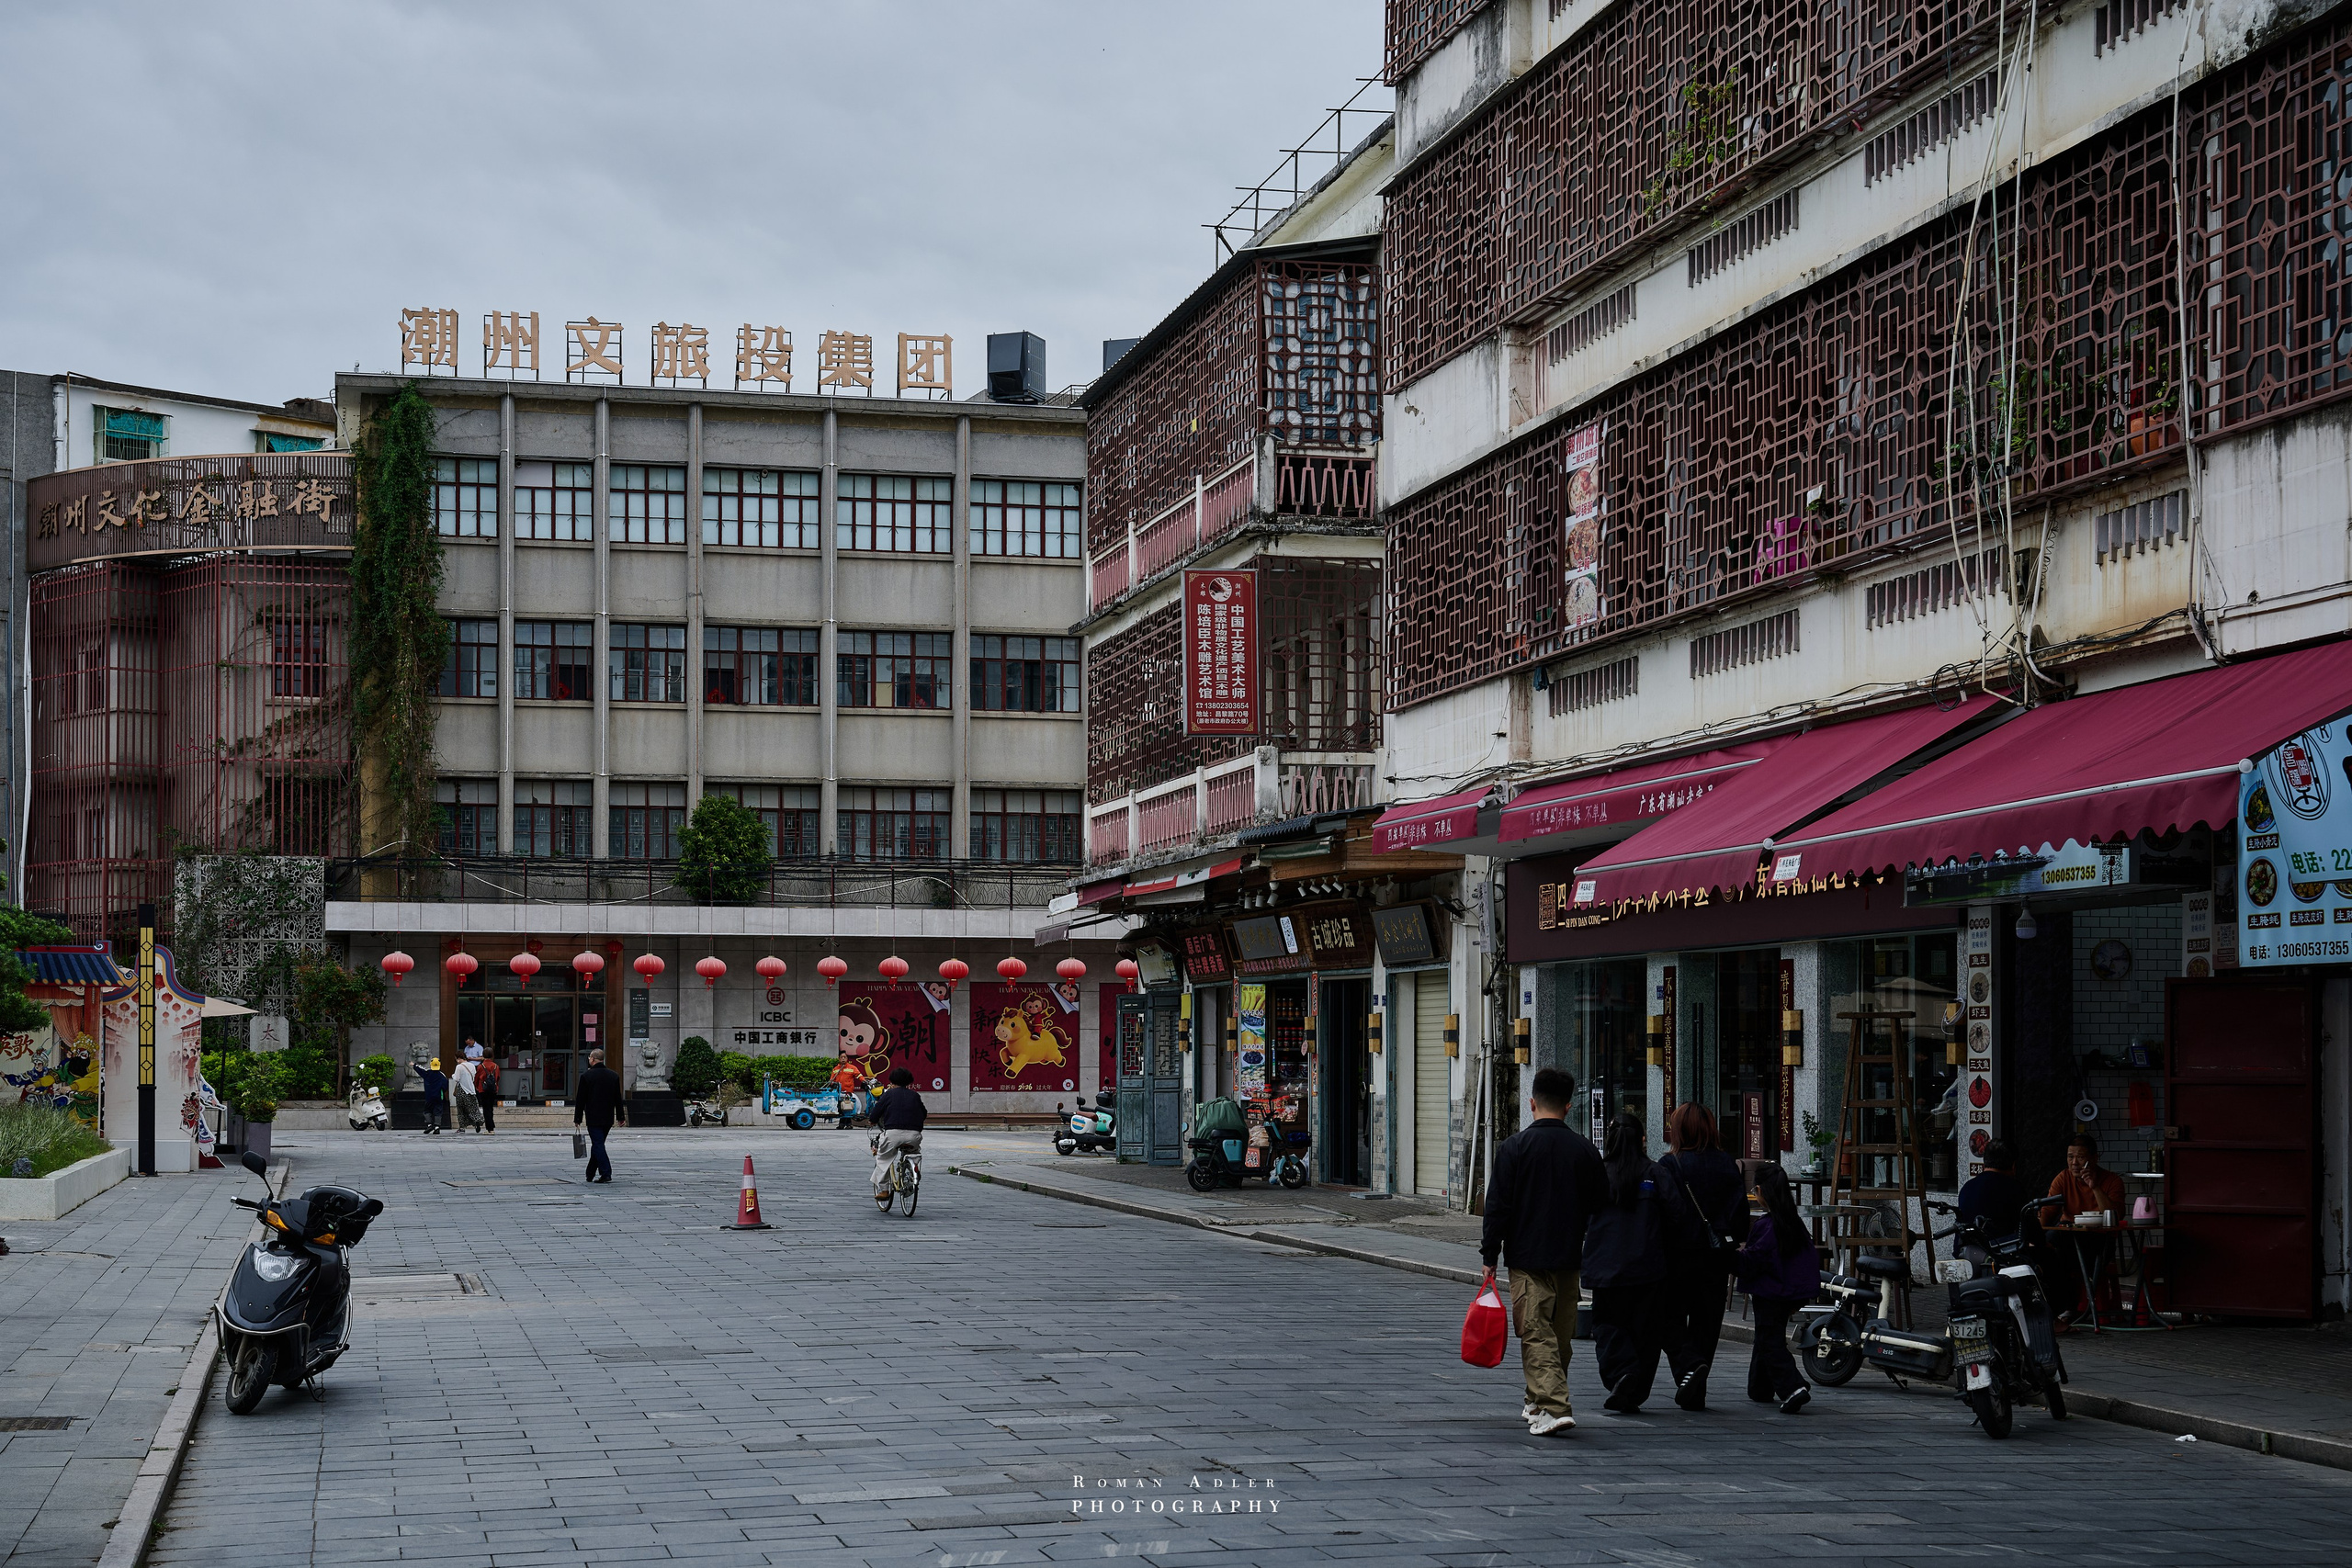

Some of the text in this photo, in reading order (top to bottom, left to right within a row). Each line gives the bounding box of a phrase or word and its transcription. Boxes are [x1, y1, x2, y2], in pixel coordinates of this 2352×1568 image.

[398, 307, 954, 390] 潮州文旅投集团
[37, 479, 339, 539] 潮州文化金融街
[1197, 604, 1213, 699] 陈培臣木雕艺术馆
[1231, 604, 1246, 699] 中国工艺美术大师
[1204, 702, 1250, 710] 13802303654
[2041, 864, 2096, 885] 13060537355
[1577, 916, 1588, 927] DAN
[1588, 915, 1600, 925] CONG
[1311, 918, 1355, 951] 古城珍品
[1971, 954, 1987, 965] 鱼生
[761, 1011, 791, 1022] ICBC
[1971, 1007, 1987, 1017] 虾生
[735, 1032, 817, 1044] 中国工商银行
[887, 1010, 937, 1064] 潮
[1970, 1060, 1990, 1070] 三文鱼
[1970, 1164, 1984, 1175] 北极
